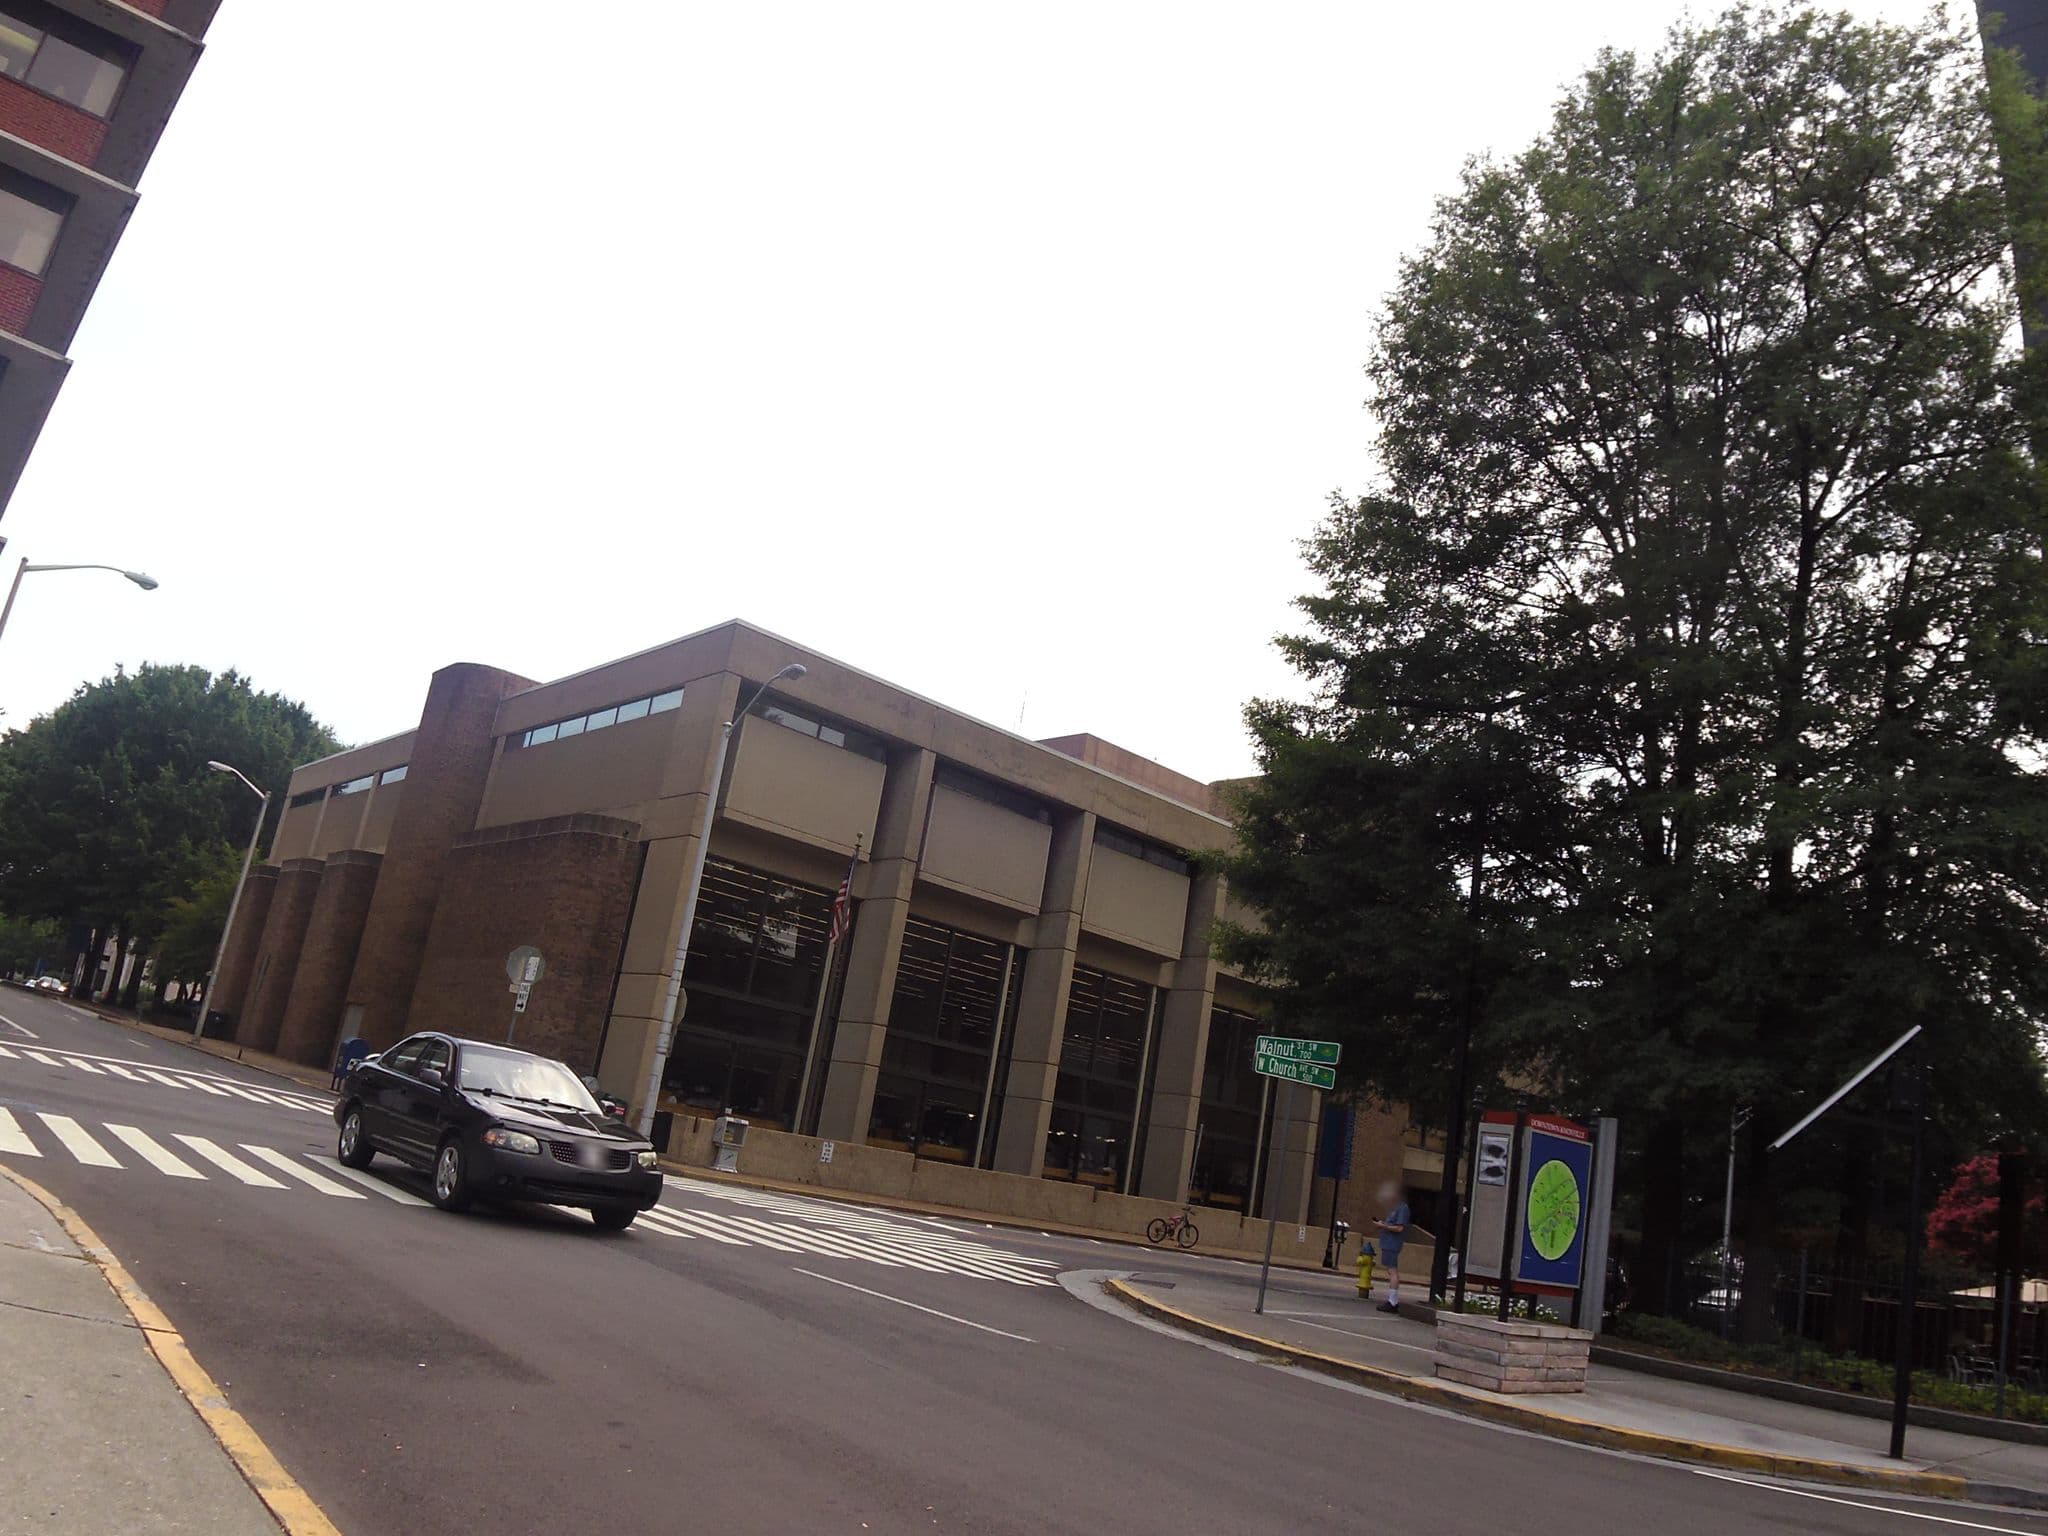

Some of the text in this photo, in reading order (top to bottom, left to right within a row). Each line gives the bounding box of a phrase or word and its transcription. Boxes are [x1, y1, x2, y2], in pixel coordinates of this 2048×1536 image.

[1260, 1039, 1318, 1057] Walnut ST SW
[1300, 1051, 1312, 1059] 700
[1258, 1057, 1320, 1078] W Church AVE SW
[1302, 1073, 1313, 1082] 500
[1531, 1119, 1560, 1131] DOWNTOWN
